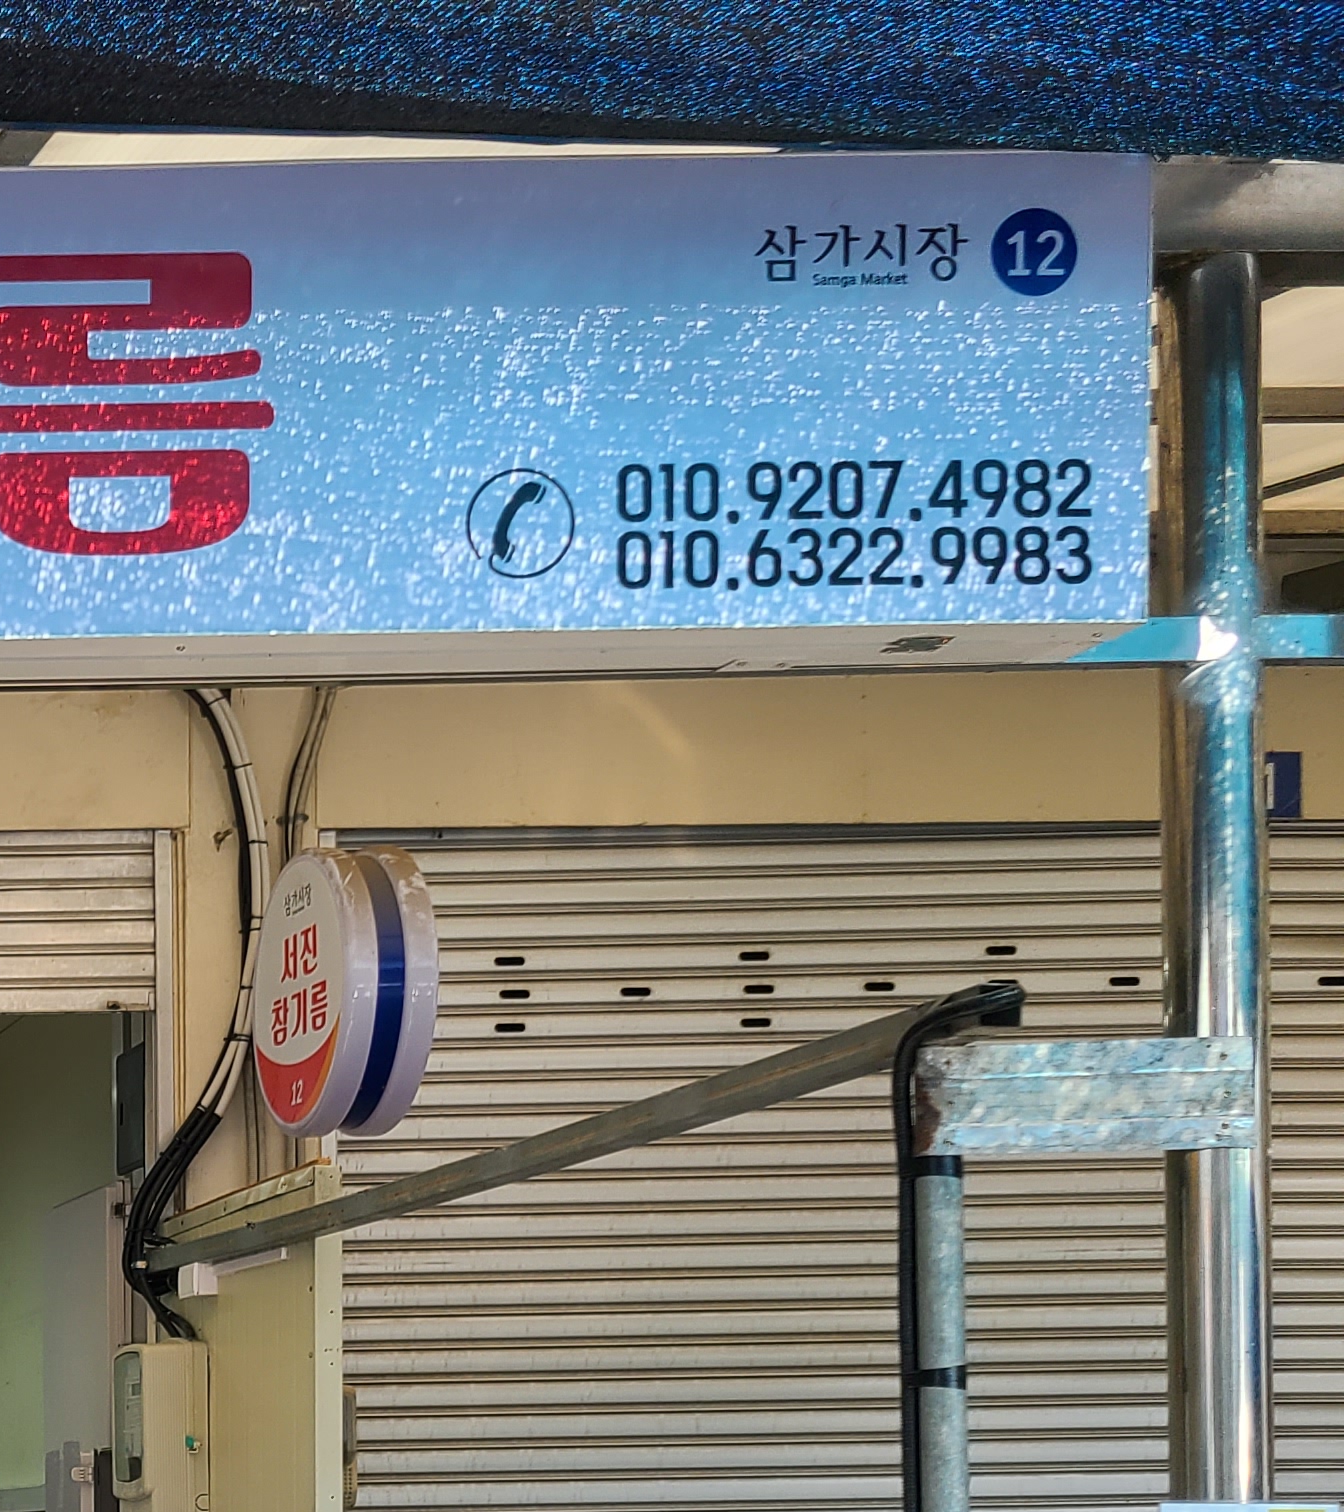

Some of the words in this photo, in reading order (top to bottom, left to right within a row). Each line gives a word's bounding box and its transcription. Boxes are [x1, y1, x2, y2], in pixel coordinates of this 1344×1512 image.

[754, 222, 970, 282] 삼가시장
[812, 273, 857, 288] Samga
[861, 272, 909, 286] Market
[1006, 229, 1066, 277] 12
[616, 458, 1094, 525] 010.9207.4982
[615, 525, 1094, 590] 010.6322.9983
[282, 882, 313, 917] 삼가시장
[280, 922, 319, 984] 서진
[270, 979, 328, 1047] 참기름
[290, 1078, 304, 1107] 12
